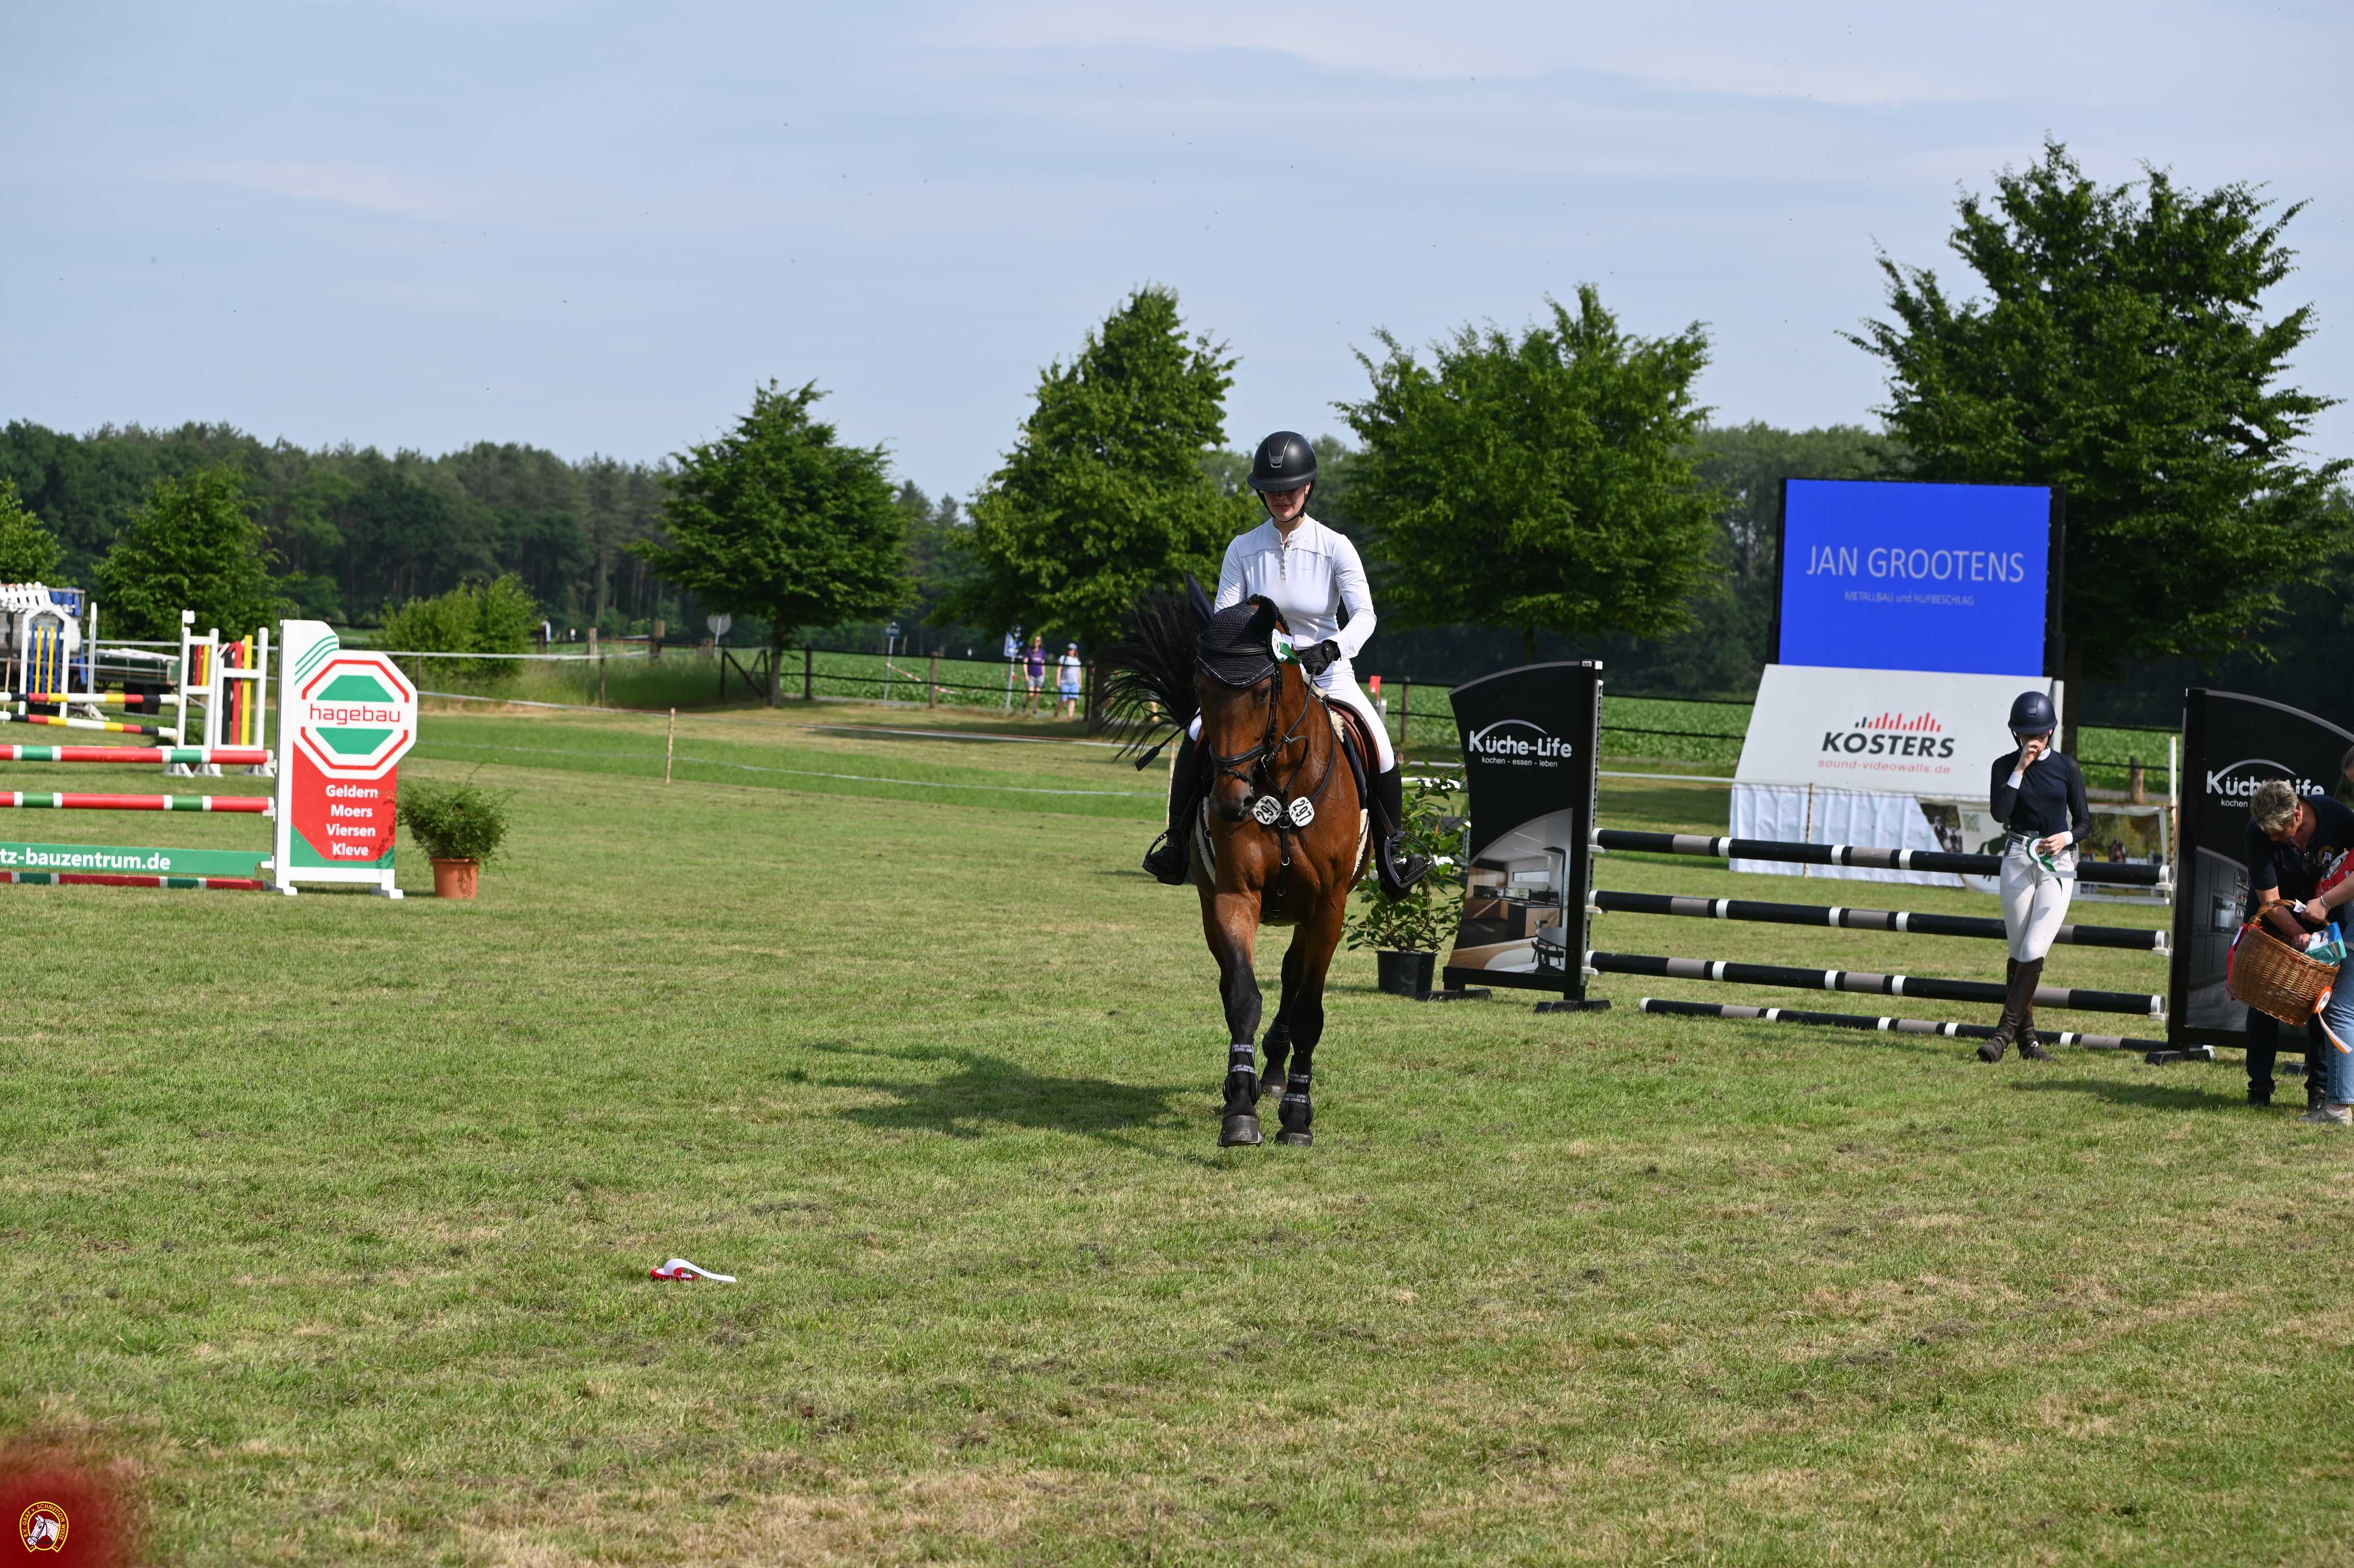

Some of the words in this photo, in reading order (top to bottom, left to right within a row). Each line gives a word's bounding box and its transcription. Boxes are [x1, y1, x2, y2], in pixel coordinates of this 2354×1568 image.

[1806, 545, 1858, 576] JAN
[1867, 547, 2024, 583] GROOTENS
[1845, 591, 1893, 603] METALLBAU
[1895, 593, 1912, 604] und
[1913, 594, 1974, 606] HUFBESCHLAG
[310, 703, 400, 725] hagebau
[1469, 730, 1572, 757] Küche-Life
[1821, 731, 1955, 759] KOSTERS
[1482, 756, 1506, 764] kochen
[1539, 759, 1558, 767] leben
[1817, 759, 1951, 774] sound-videowalls.de
[325, 784, 378, 799] Geldern
[1256, 799, 1279, 822] 297
[1292, 799, 1312, 822] 297
[2221, 798, 2248, 808] kochen
[330, 804, 373, 818] Moers
[325, 823, 376, 837] Viersen
[332, 842, 370, 856] Kleve
[0, 847, 171, 870] tz-bauzentrum.de
